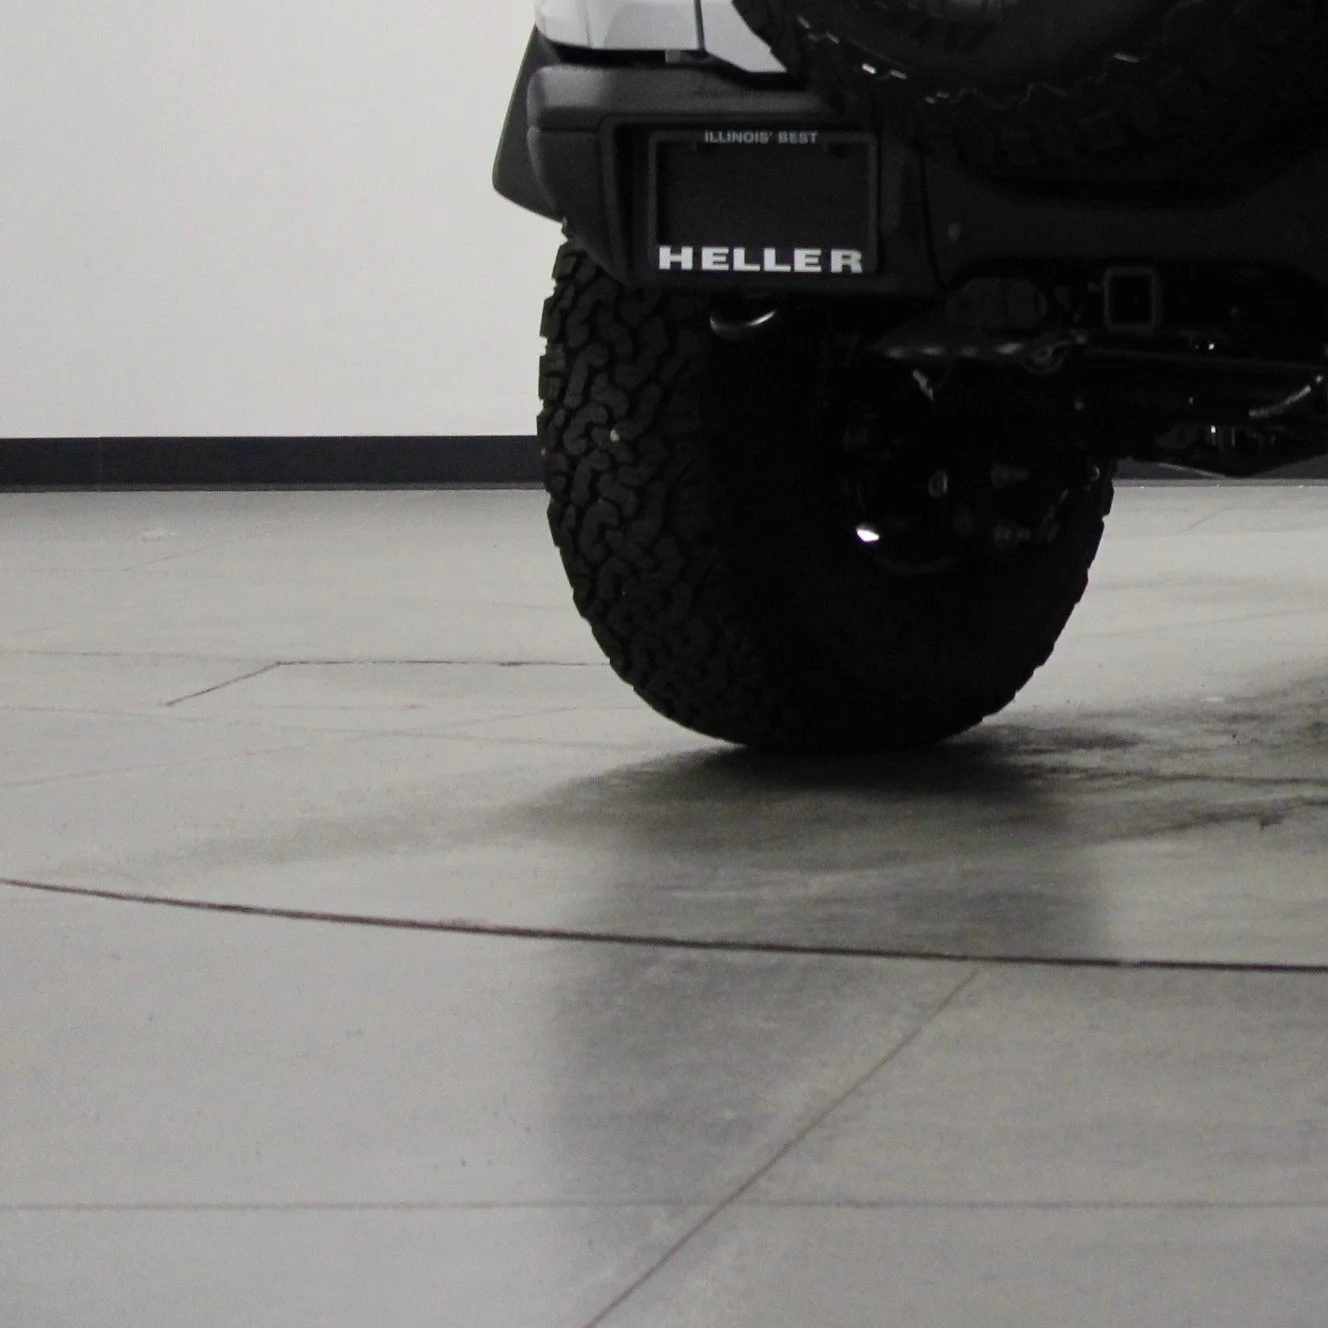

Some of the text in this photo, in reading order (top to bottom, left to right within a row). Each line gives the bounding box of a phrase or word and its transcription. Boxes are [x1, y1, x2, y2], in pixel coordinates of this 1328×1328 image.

[704, 130, 819, 144] ILLINOIS' BEST
[658, 245, 863, 274] HELLER
